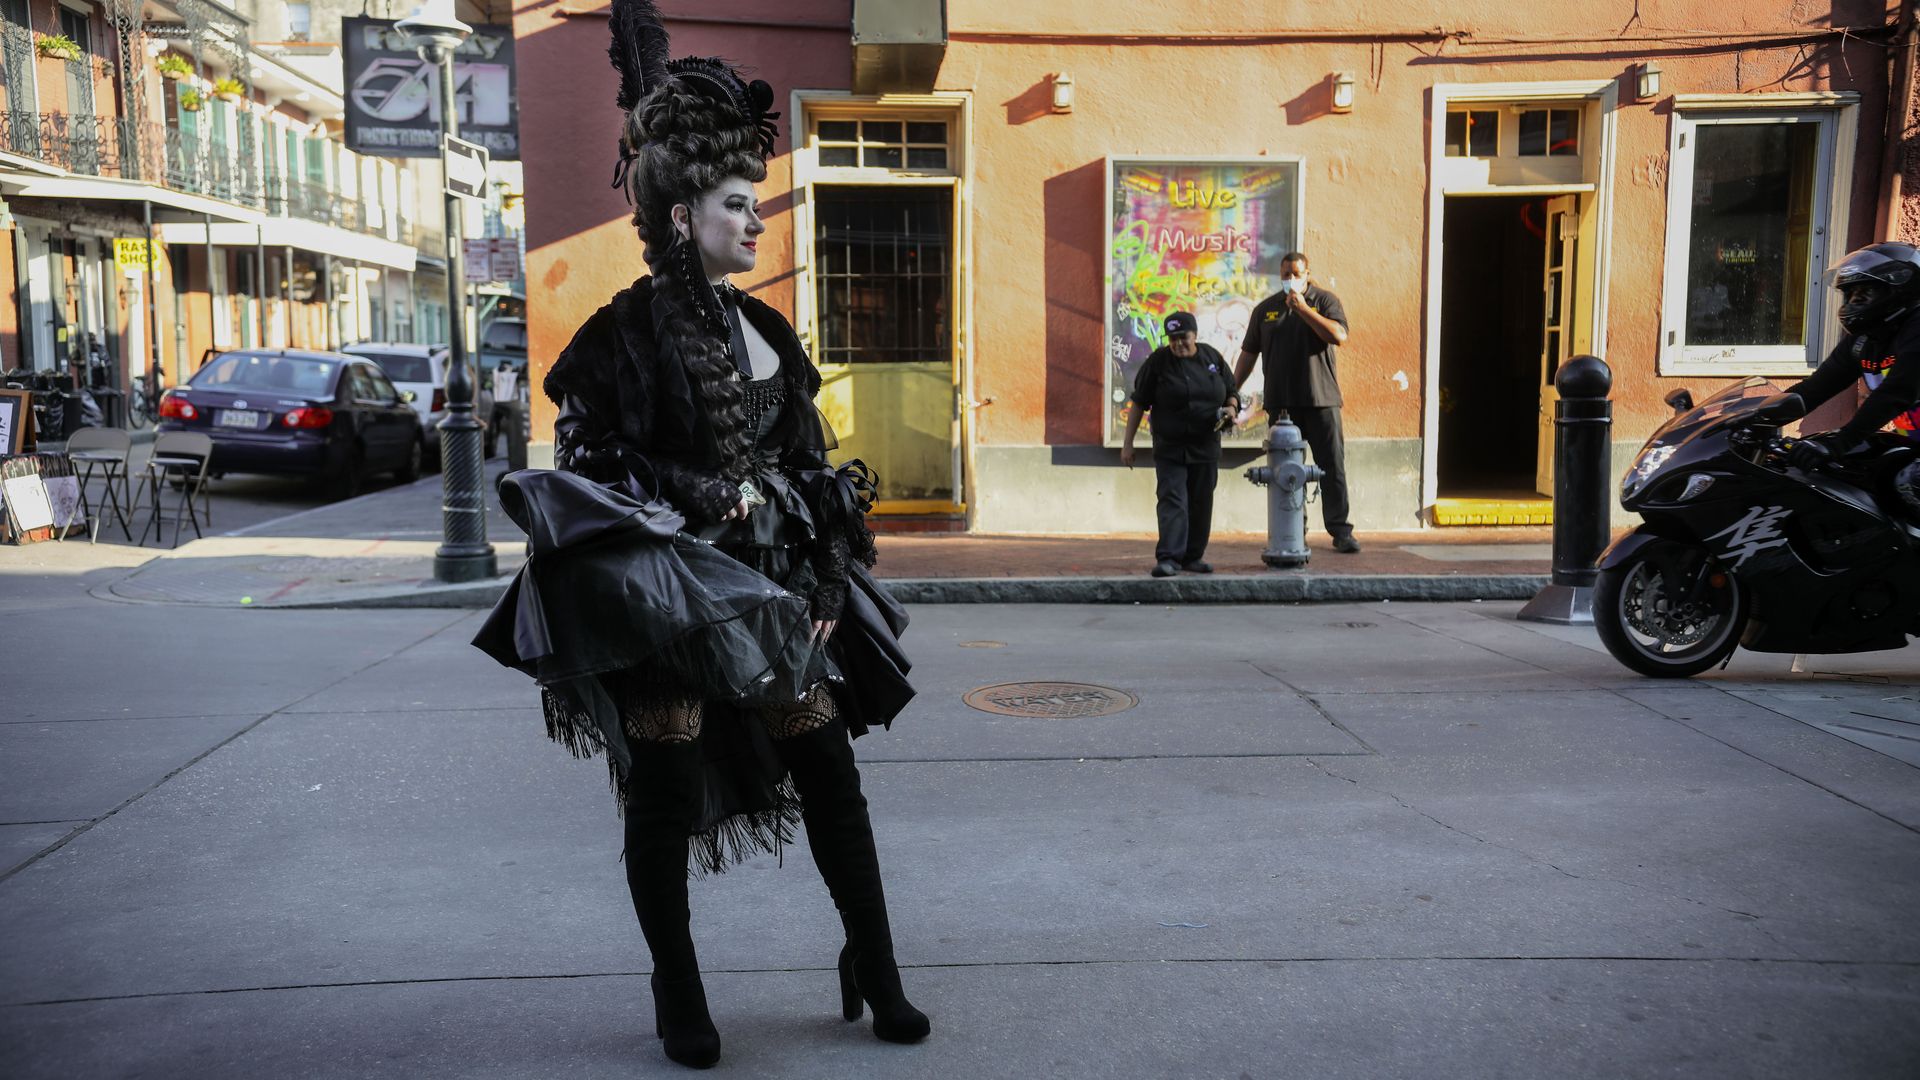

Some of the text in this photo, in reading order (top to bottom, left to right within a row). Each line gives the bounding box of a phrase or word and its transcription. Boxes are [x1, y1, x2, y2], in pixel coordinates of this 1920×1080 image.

[1169, 179, 1237, 209] Live
[1156, 226, 1251, 253] Music
[741, 486, 754, 498] 20
